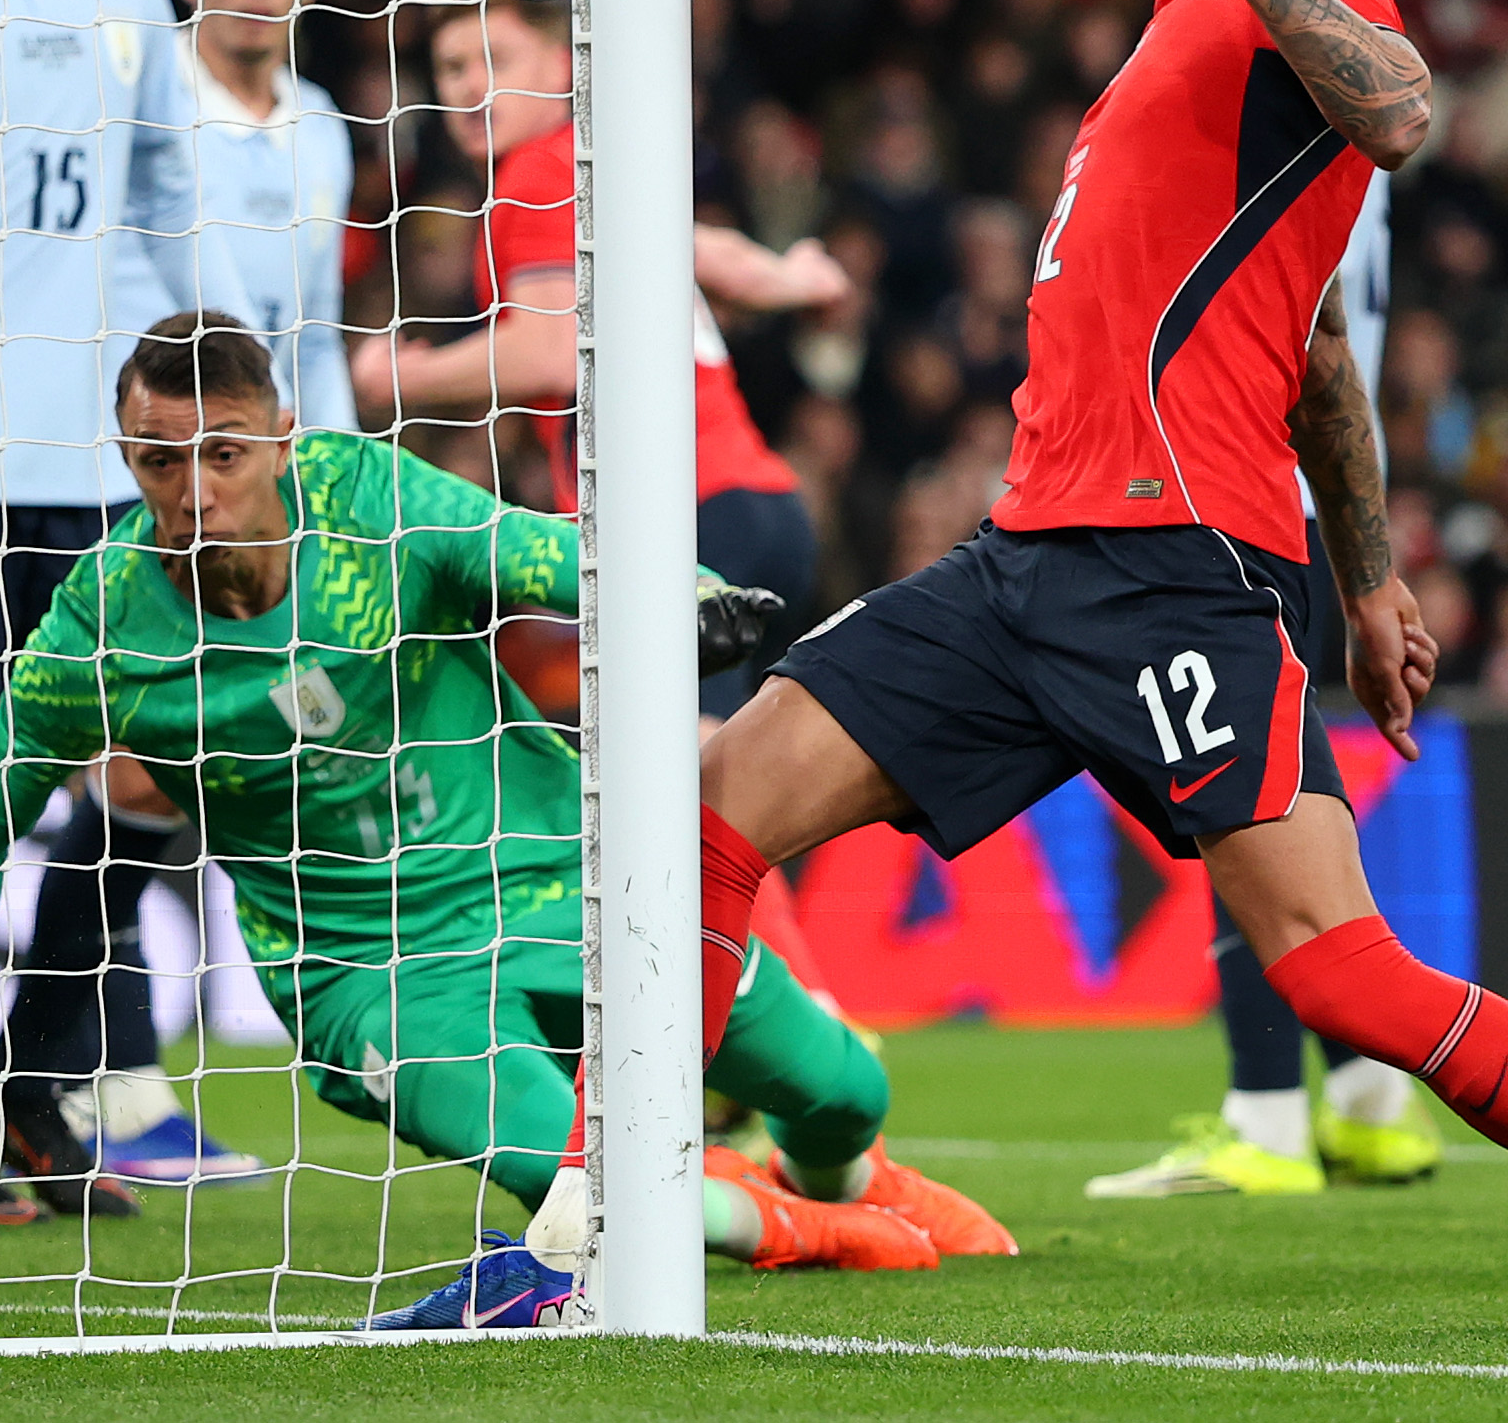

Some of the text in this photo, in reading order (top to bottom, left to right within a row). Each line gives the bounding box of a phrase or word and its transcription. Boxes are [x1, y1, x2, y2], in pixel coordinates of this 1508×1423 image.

[27, 147, 86, 232] 15
[1035, 181, 1079, 283] 2
[1136, 649, 1236, 764] 12
